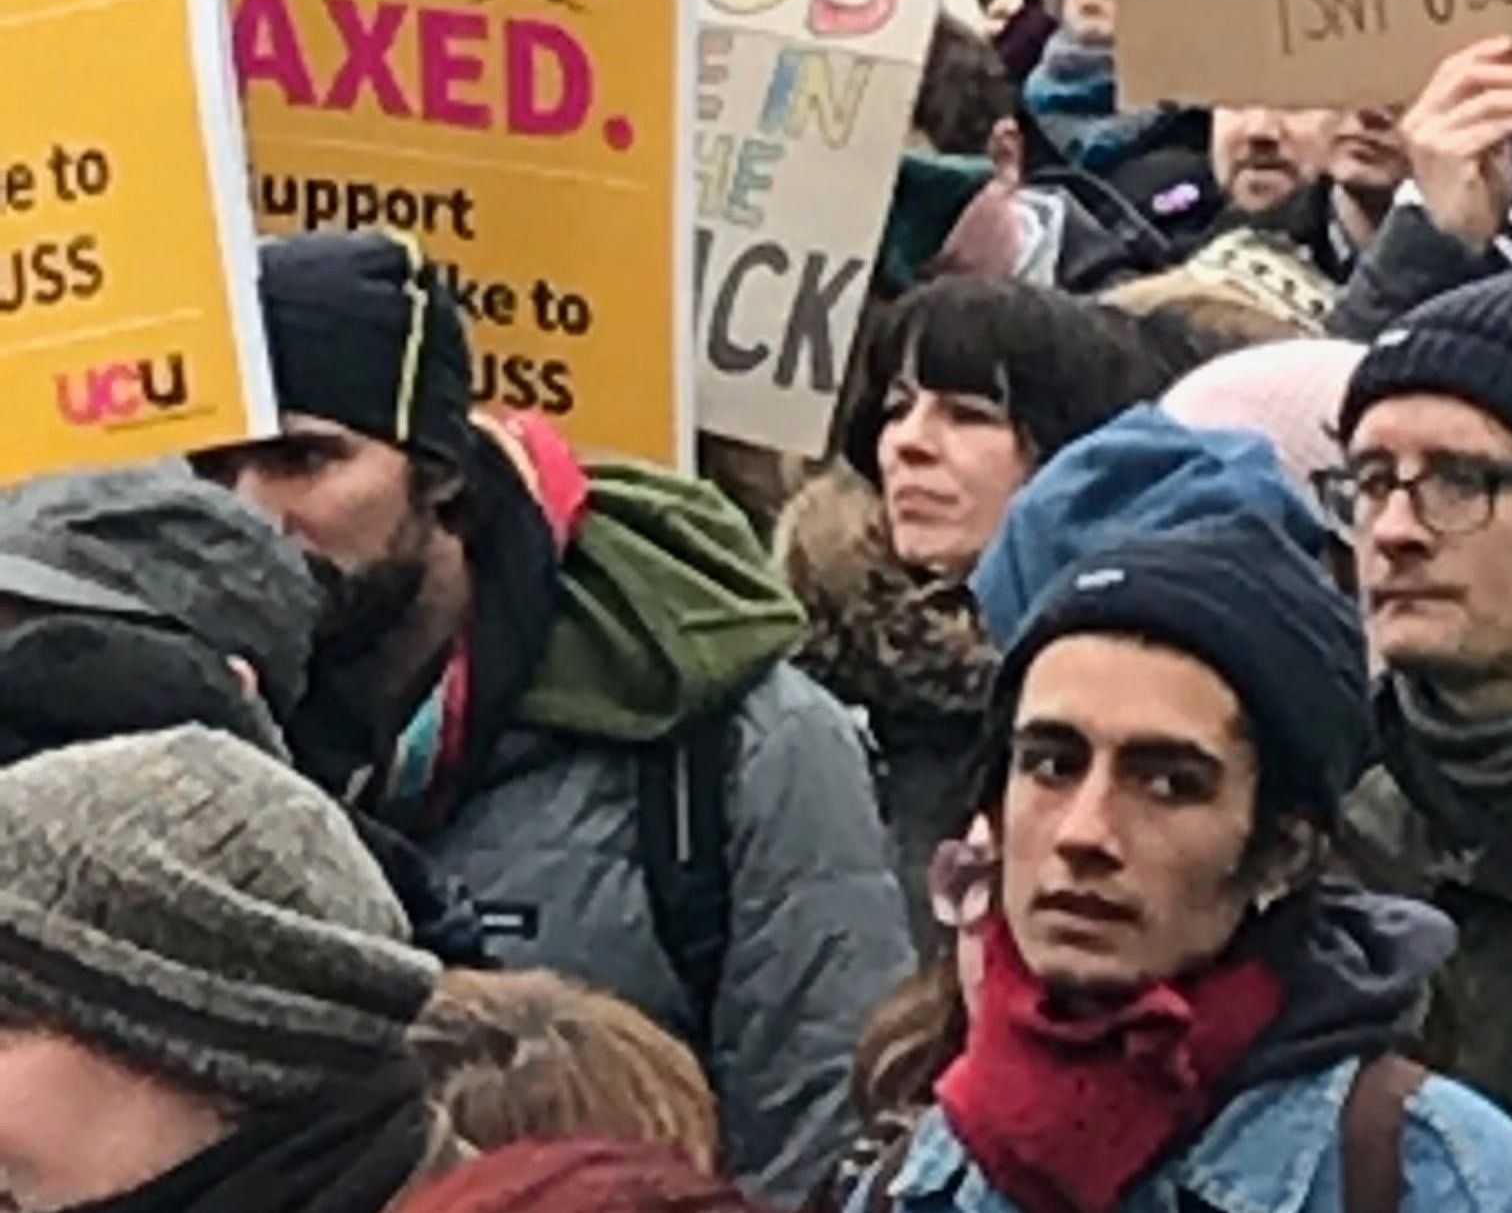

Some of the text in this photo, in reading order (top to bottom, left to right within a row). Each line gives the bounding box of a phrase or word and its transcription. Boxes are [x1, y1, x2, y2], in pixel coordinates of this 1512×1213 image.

[50, 143, 109, 203] to
[256, 173, 475, 241] upport
[531, 277, 594, 337] to
